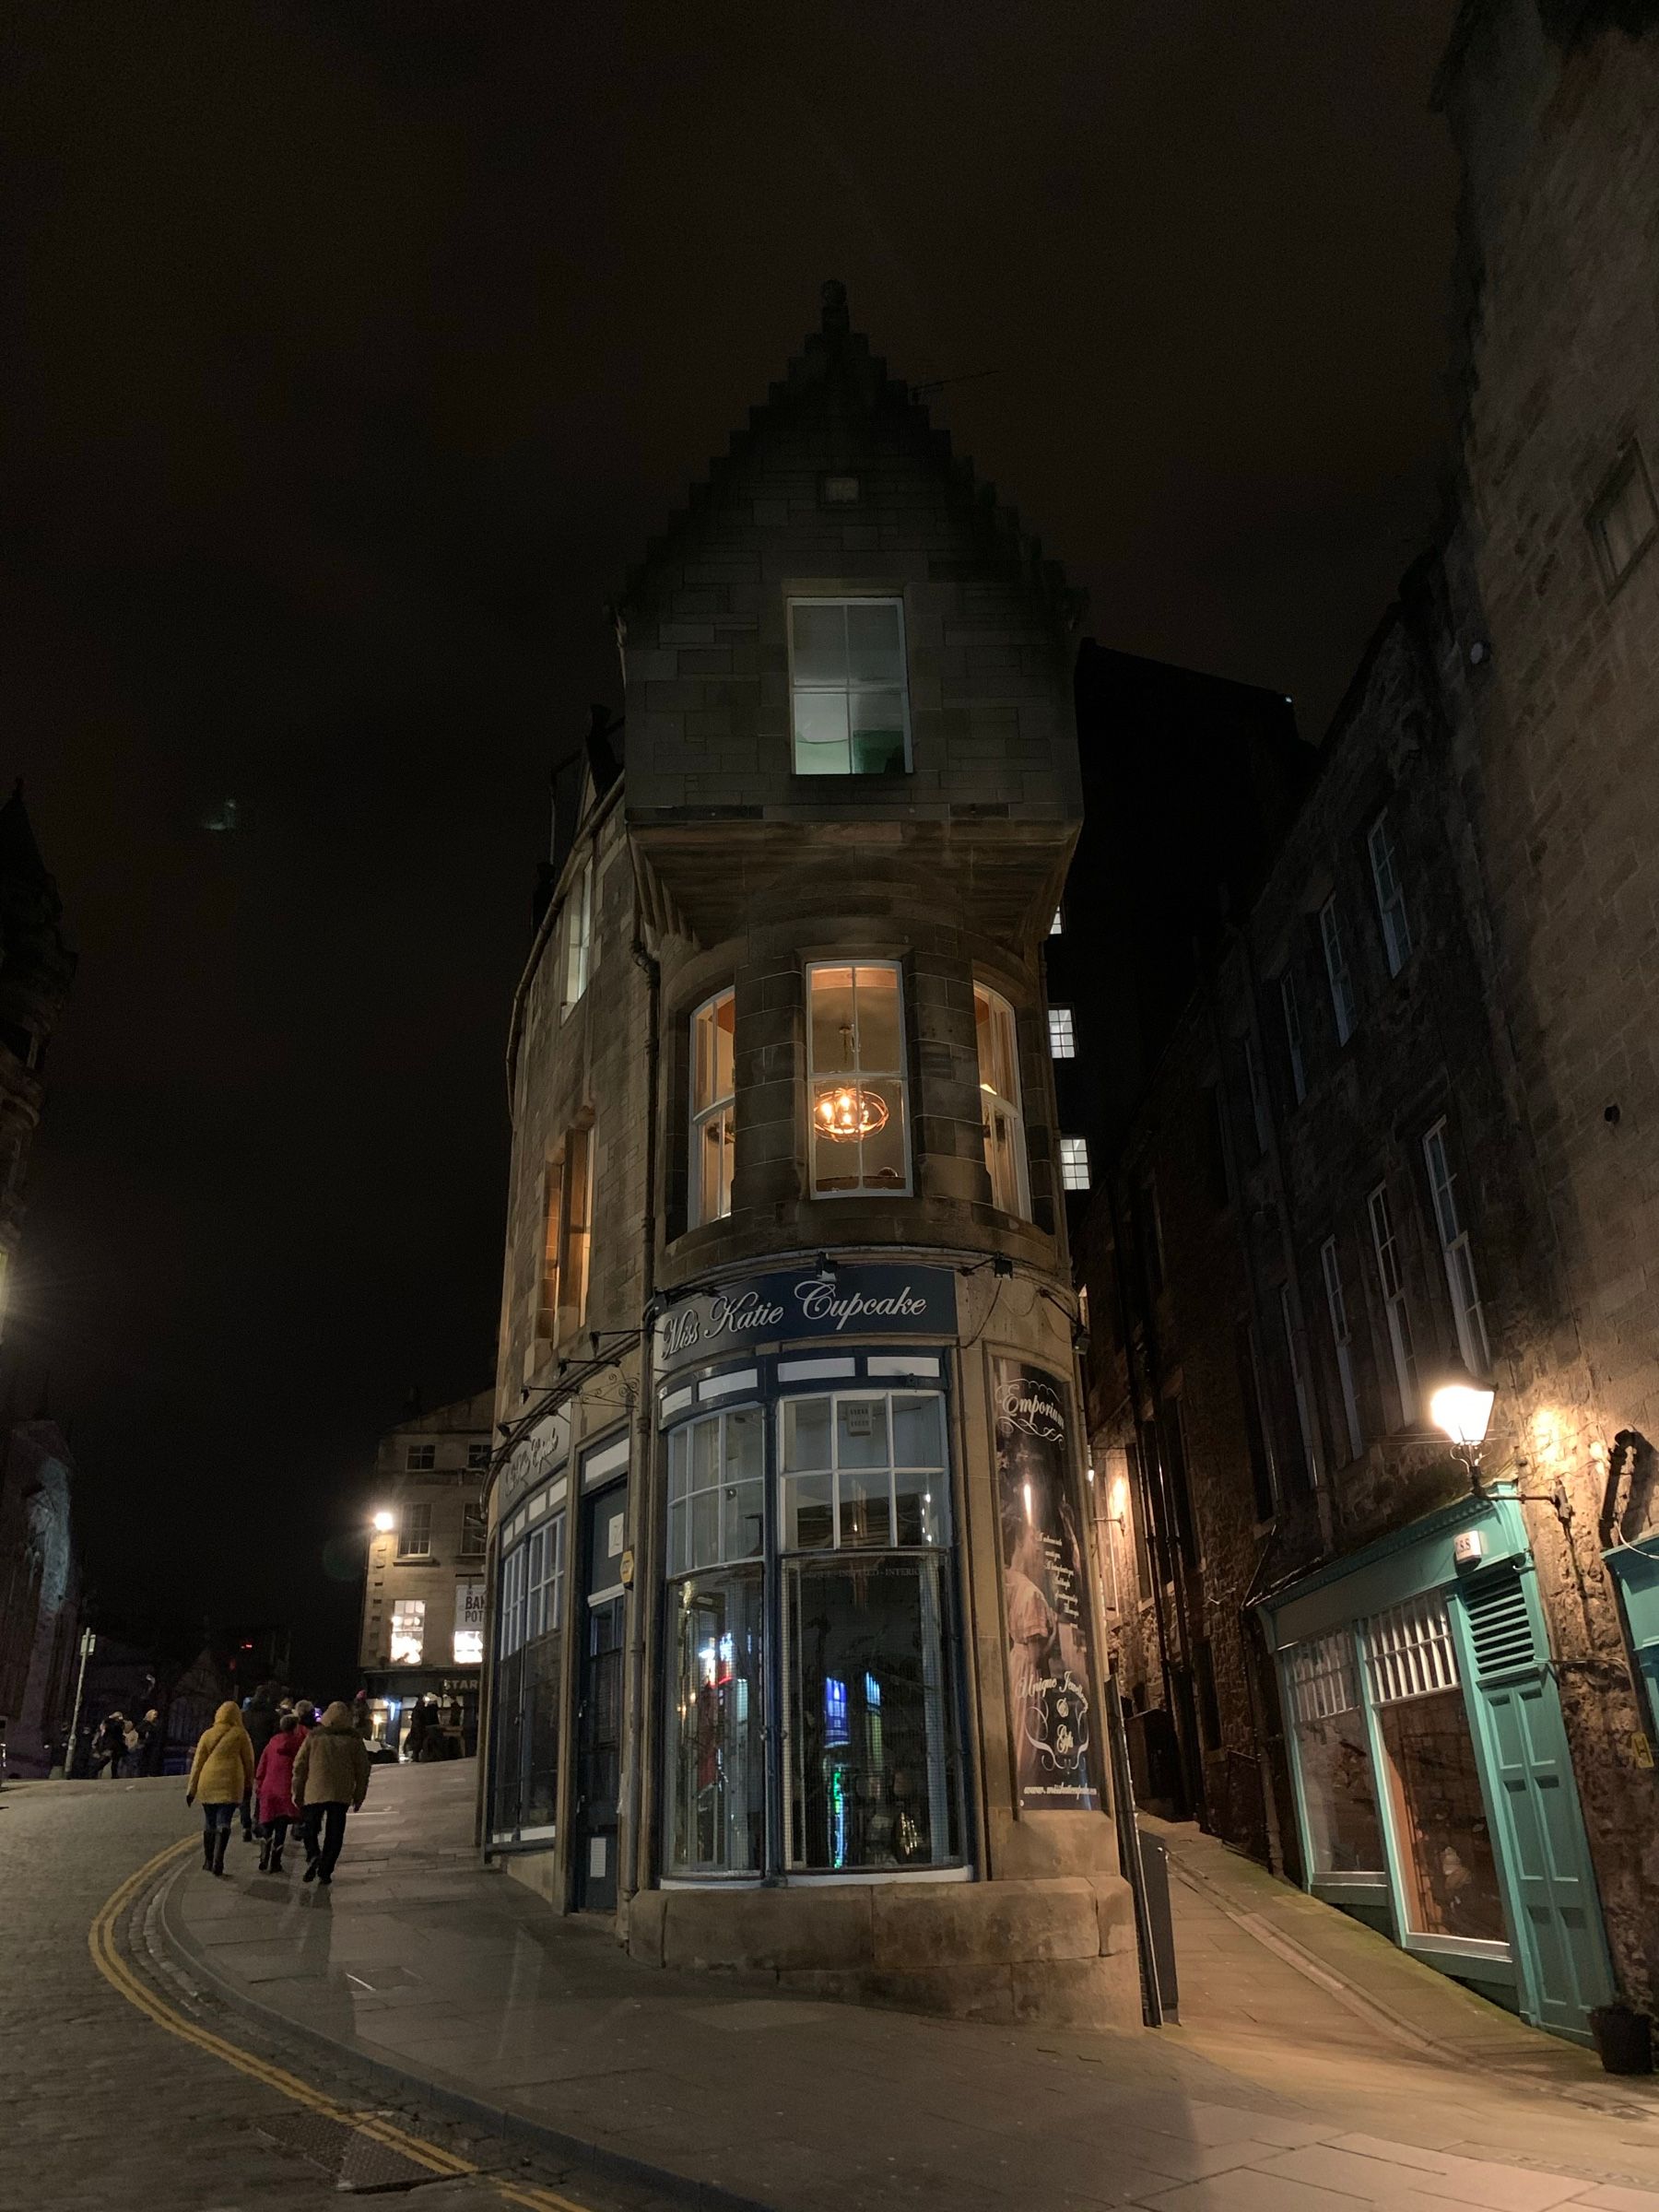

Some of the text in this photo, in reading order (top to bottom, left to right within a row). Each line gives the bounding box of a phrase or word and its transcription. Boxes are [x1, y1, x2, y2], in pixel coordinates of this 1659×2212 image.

[662, 1280, 927, 1359] Miss Katie Cupcake
[1001, 1383, 1065, 1430] Emporium
[1016, 1676, 1058, 1698] Unique
[1633, 1737, 1652, 1763] H
